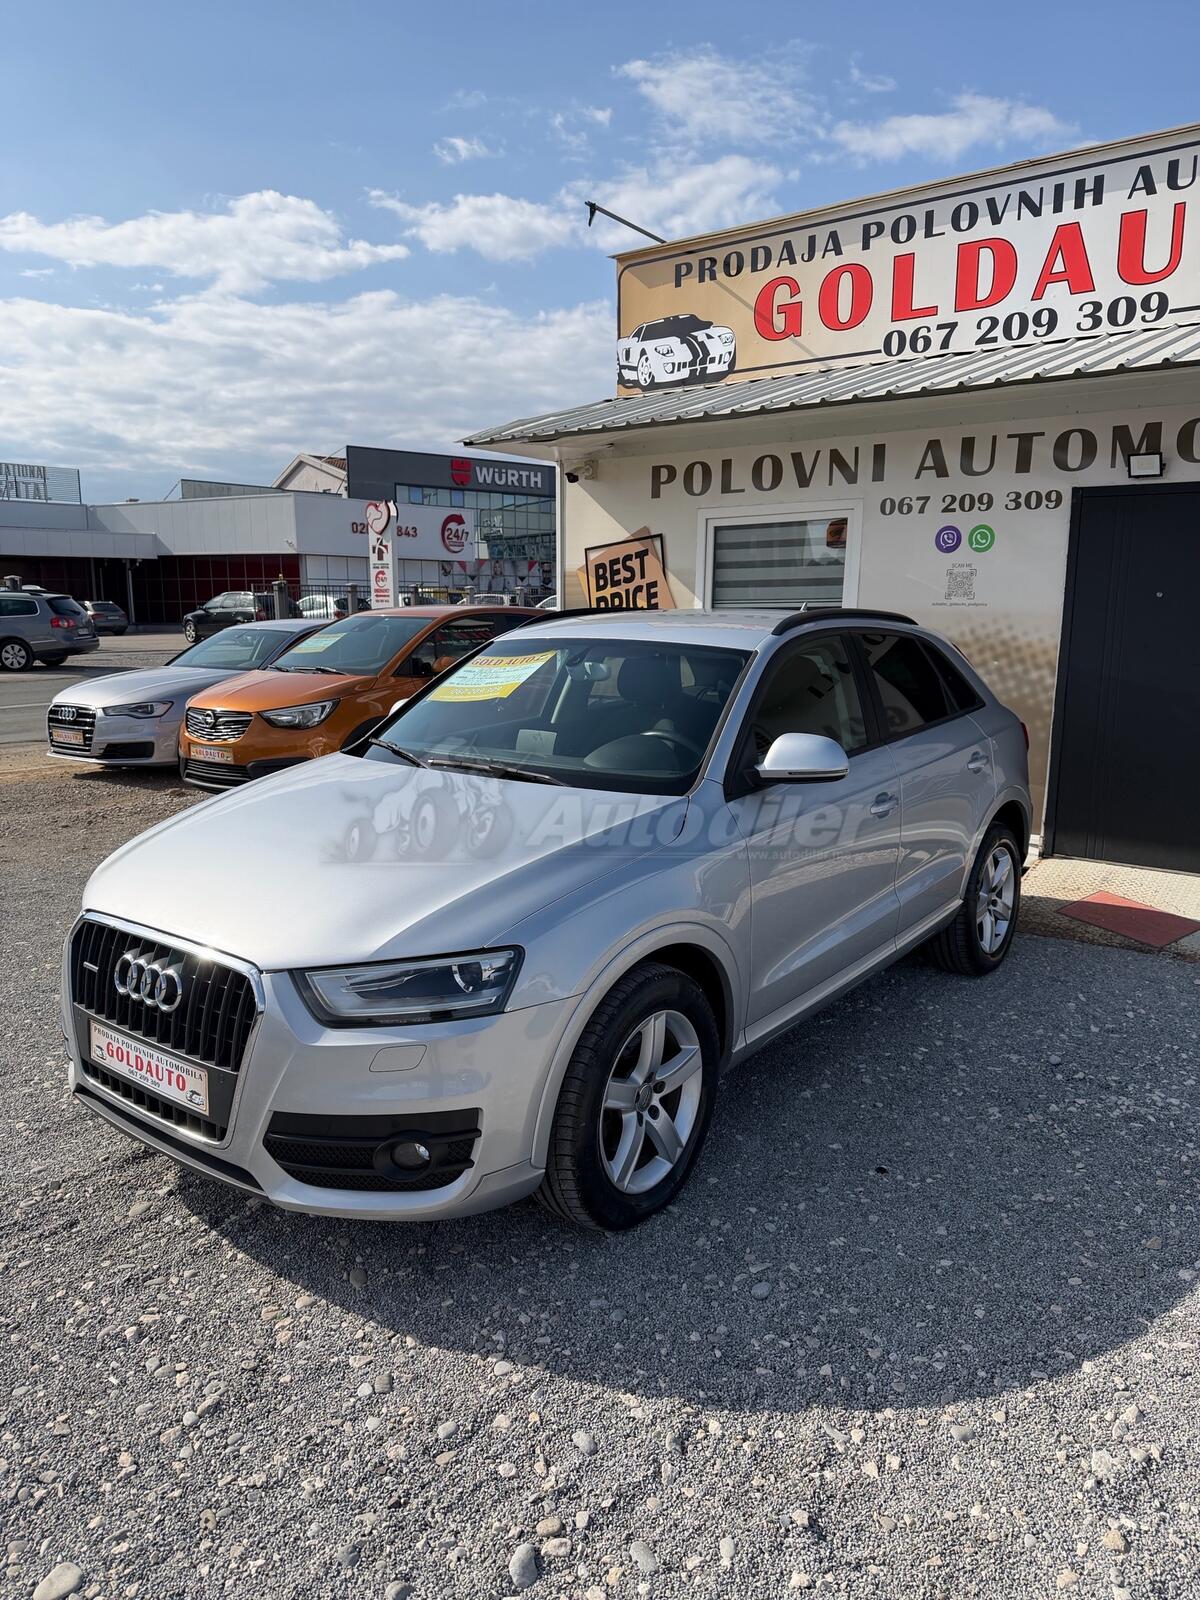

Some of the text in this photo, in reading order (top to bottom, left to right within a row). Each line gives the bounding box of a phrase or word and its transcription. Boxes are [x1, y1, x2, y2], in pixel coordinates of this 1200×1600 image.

[674, 154, 1199, 288] PRODAJA POLOVNIH AU
[753, 201, 1187, 341] GOLDAU
[882, 291, 1170, 357] 067 209 309
[475, 466, 542, 488] WÜRTH
[650, 443, 886, 499] POLOVNI
[880, 489, 1063, 516] 067 209 309
[351, 522, 369, 534] 02
[446, 527, 469, 542] 24/7
[594, 548, 649, 592] BEST
[471, 655, 536, 666] GOLD AUTO
[106, 1041, 187, 1092] GOLDAUTO
[121, 1040, 155, 1060] POLOVNIH
[156, 1055, 204, 1081] AUTOMOBILA
